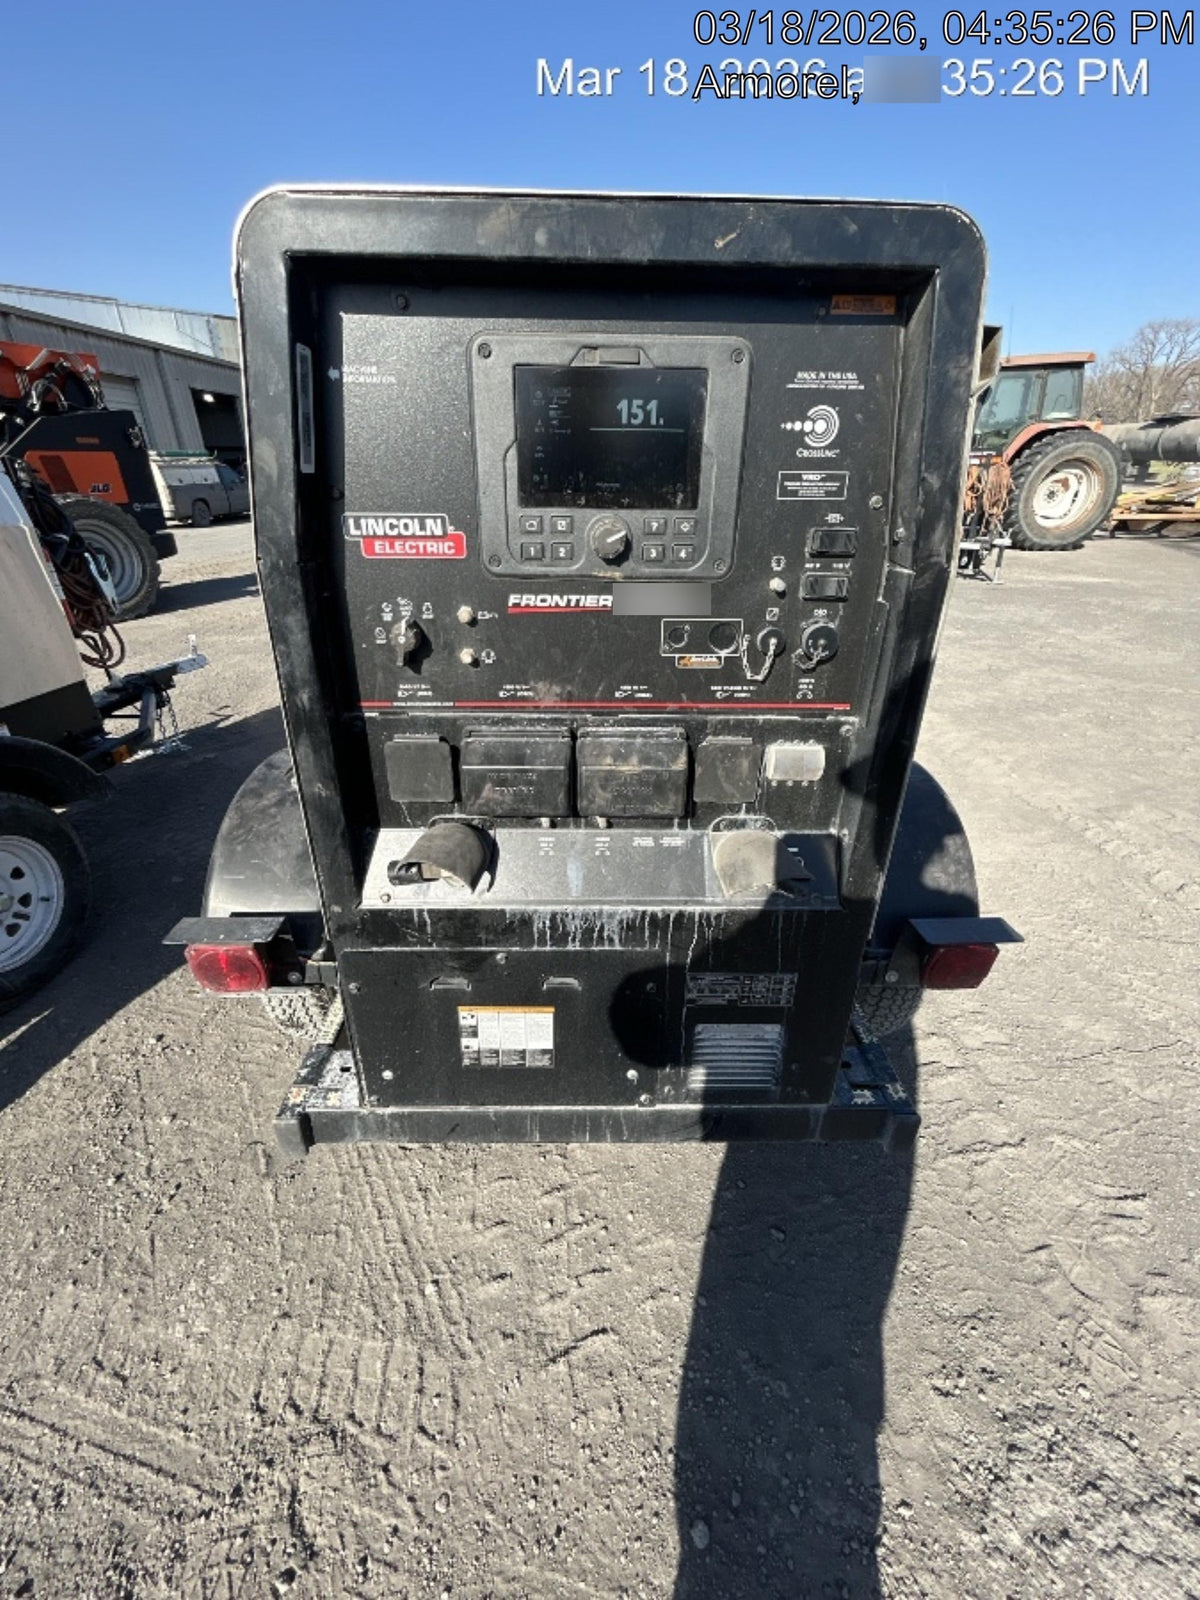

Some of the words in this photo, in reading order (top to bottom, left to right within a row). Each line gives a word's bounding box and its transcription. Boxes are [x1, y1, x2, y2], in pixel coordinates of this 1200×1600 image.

[90, 483, 112, 493] JLG
[348, 518, 443, 536] LINCOLN
[374, 541, 456, 554] ELECTRIC
[559, 548, 566, 557] 2
[679, 549, 687, 559] 4
[508, 594, 613, 607] FRONTIER
